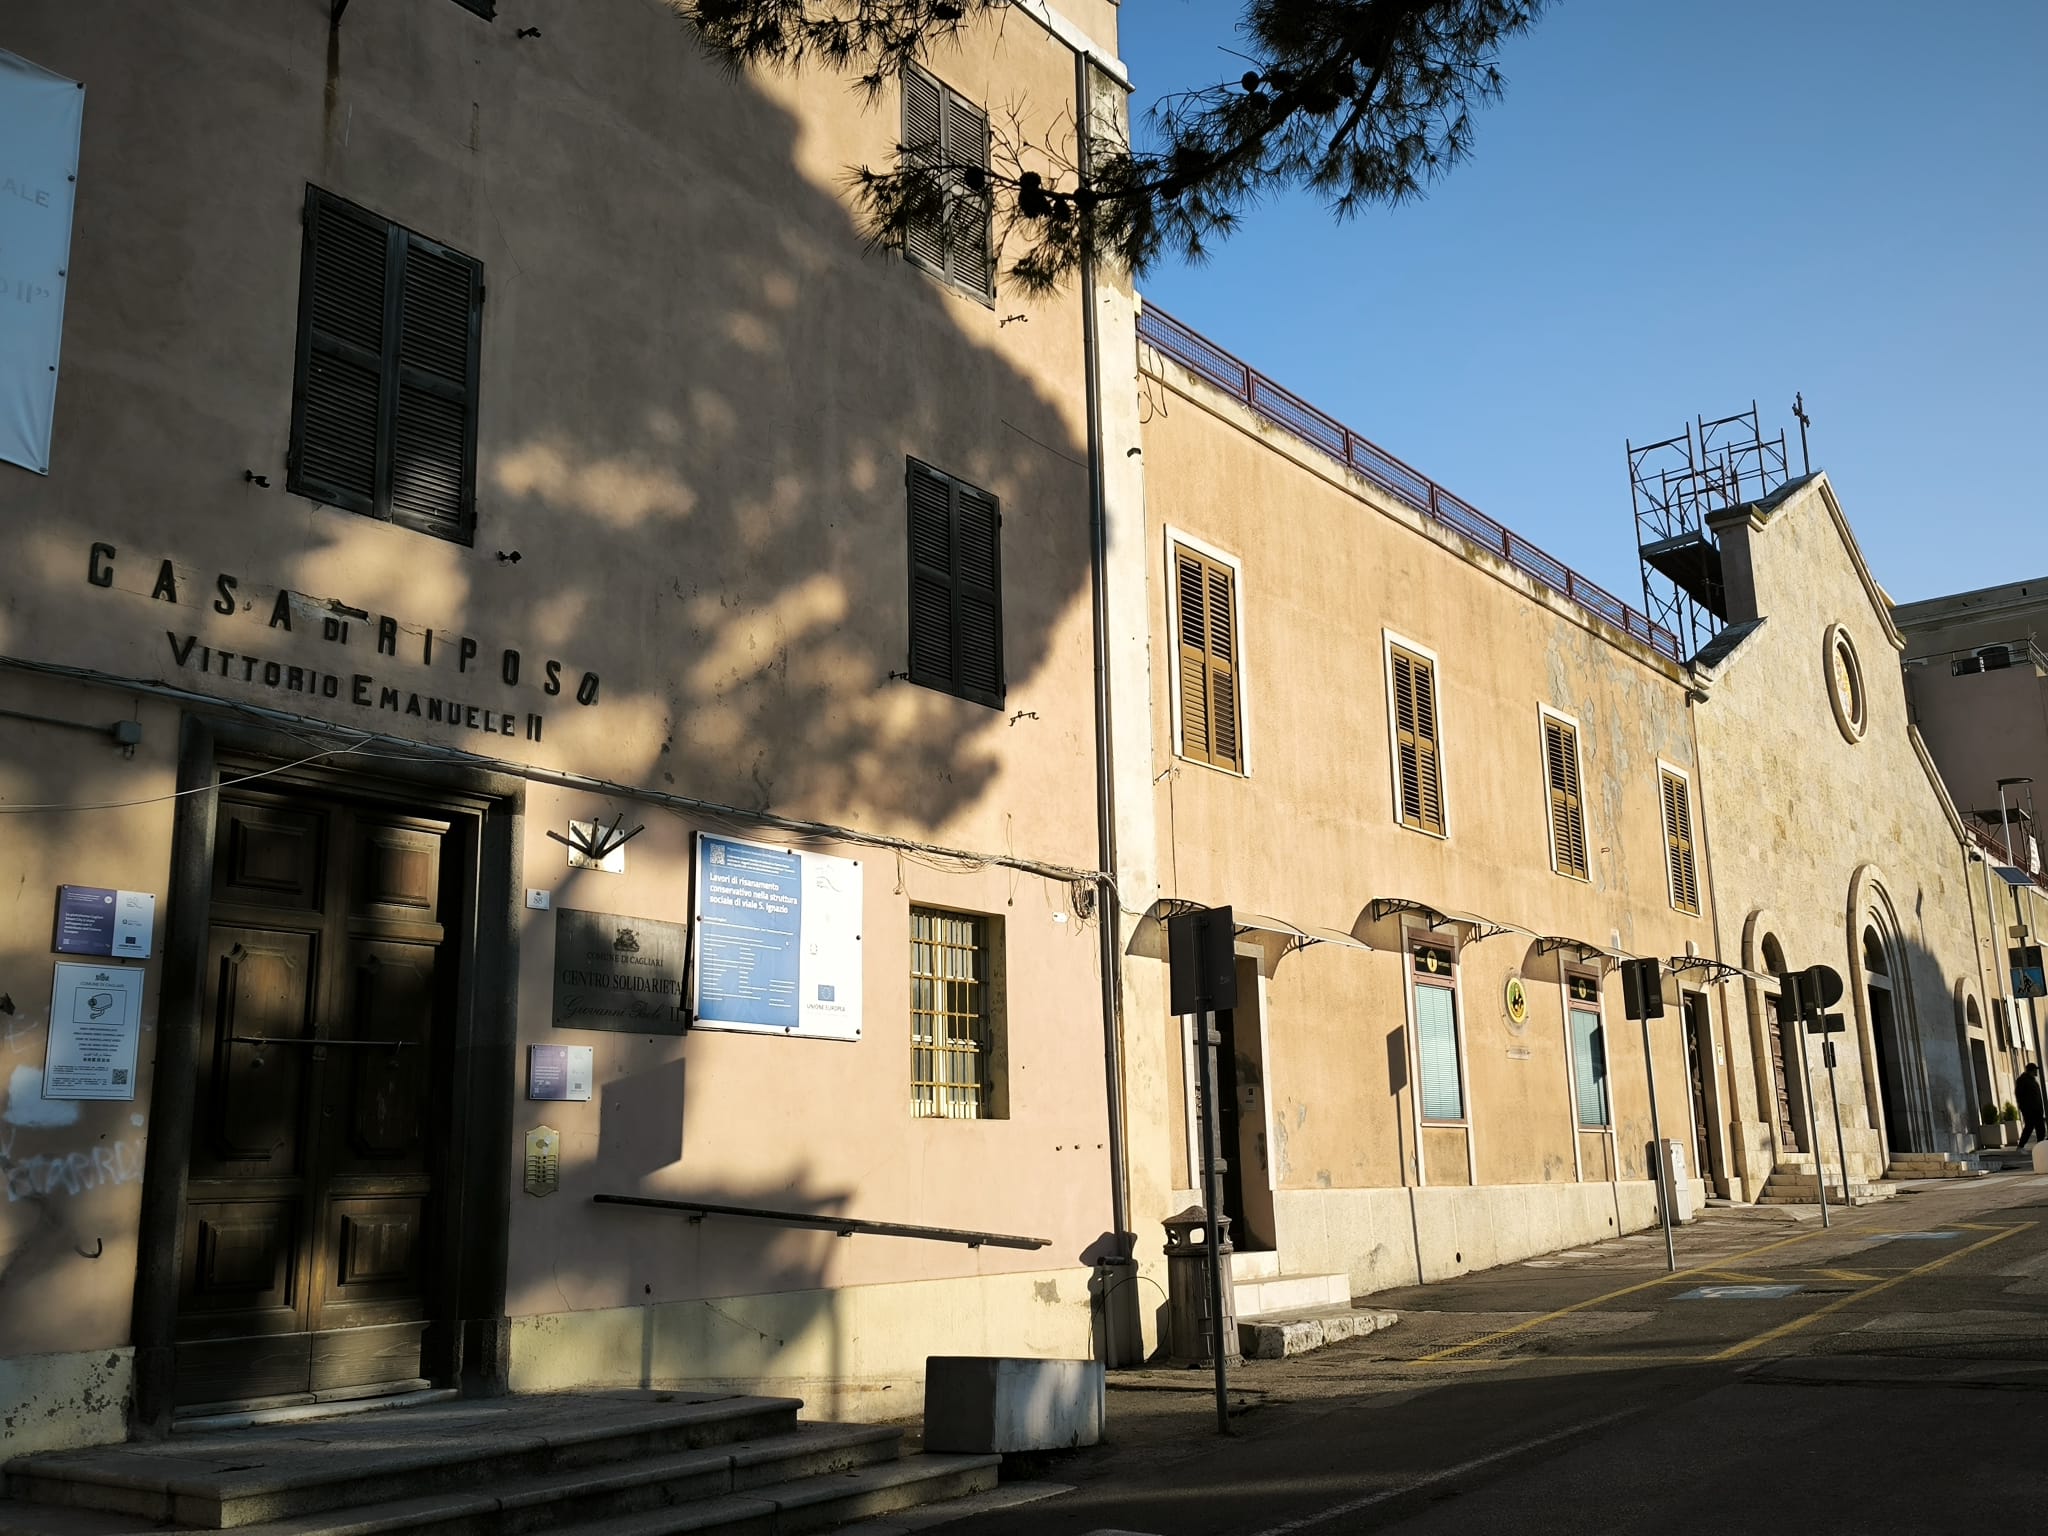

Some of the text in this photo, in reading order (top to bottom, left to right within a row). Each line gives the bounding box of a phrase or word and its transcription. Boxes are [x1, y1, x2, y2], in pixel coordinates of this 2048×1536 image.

[88, 541, 600, 707] CASA DI RIPOSO
[525, 714, 543, 742] II
[731, 876, 738, 884] di
[710, 884, 798, 904] conservativo nella struttura
[734, 898, 740, 906] di
[742, 899, 758, 909] viale
[630, 956, 664, 968] CAGLIARI
[562, 969, 610, 988] CENTRO
